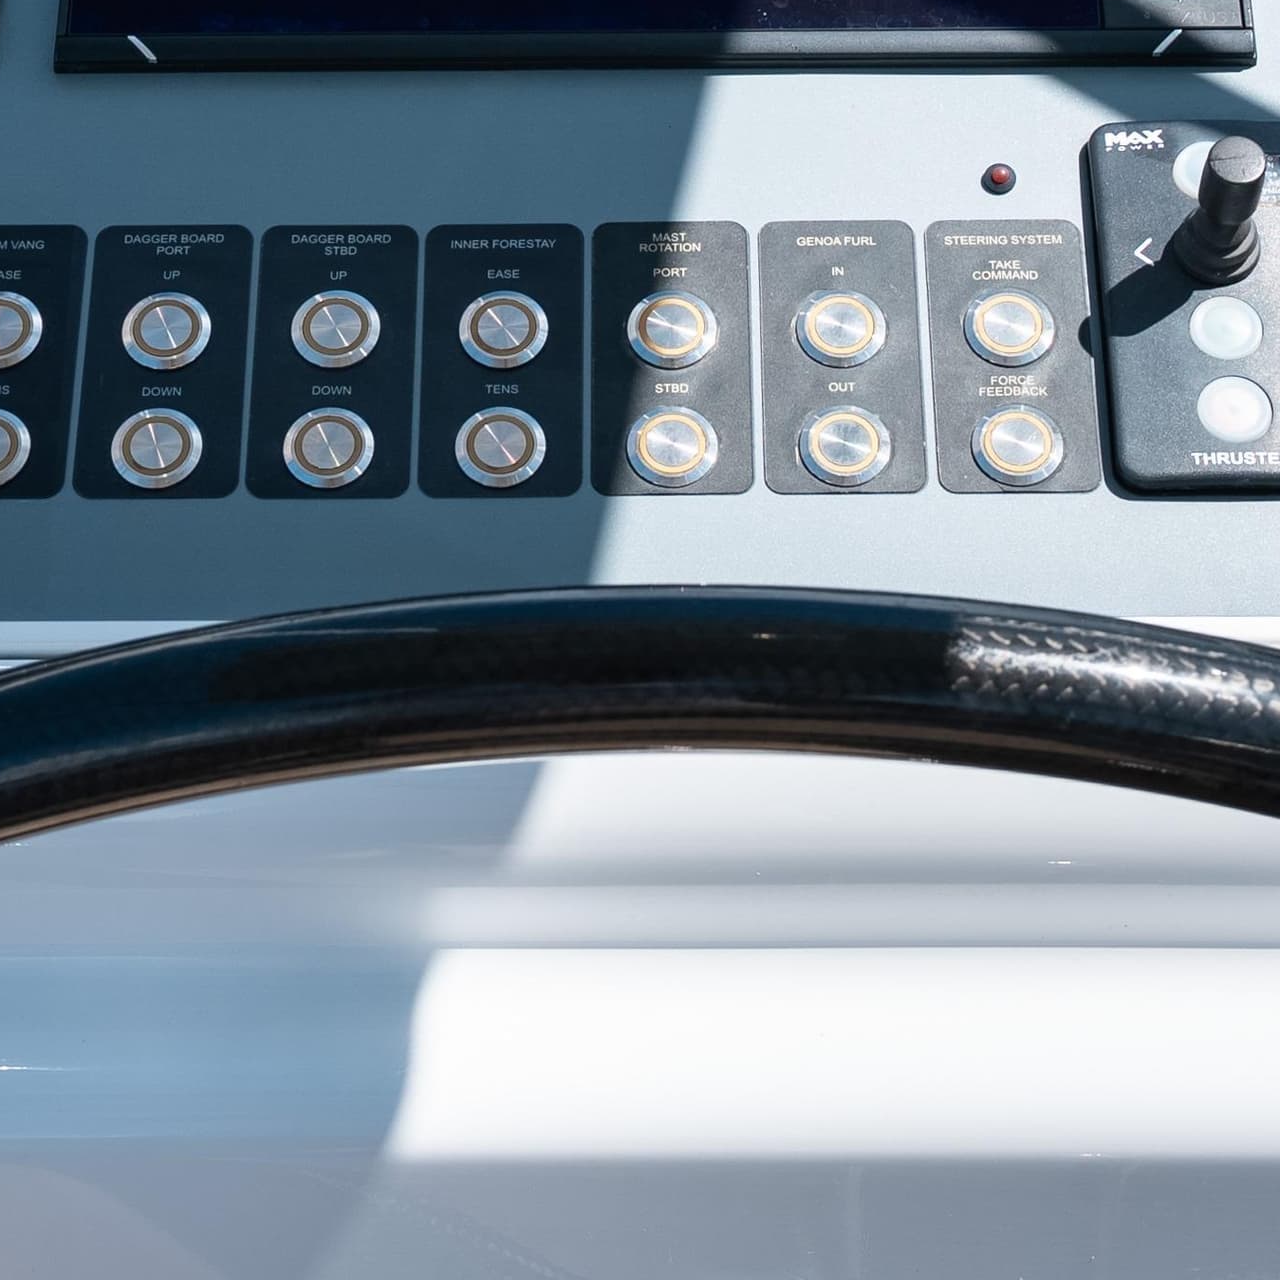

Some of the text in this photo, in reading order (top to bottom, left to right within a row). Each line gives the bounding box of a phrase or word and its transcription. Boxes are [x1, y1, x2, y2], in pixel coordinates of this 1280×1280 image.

[1104, 128, 1164, 146] MAX
[1105, 144, 1164, 152] POWER
[124, 234, 226, 244] DAGGER BOARD
[290, 234, 392, 245] DAGGER BOARD
[652, 232, 688, 244] MAST
[796, 236, 877, 247] GENOA FURL
[944, 234, 1062, 246] STEERING SYSTEM
[9, 240, 46, 250] VANG
[450, 238, 556, 250] INNER FORESTAY
[638, 242, 702, 253] ROTATION
[156, 246, 191, 256] PORT
[324, 246, 358, 256] STBD
[988, 260, 1022, 270] TAKE
[162, 270, 181, 280] UP
[329, 270, 348, 280] UP
[486, 268, 520, 280] EASE
[652, 267, 688, 278] PORT
[831, 266, 844, 276] IN
[972, 270, 1039, 282] COMMAND
[990, 376, 1035, 386] FORCE
[142, 386, 182, 397] DOWN
[311, 386, 352, 396] DOWN
[485, 384, 520, 395] TENS
[654, 383, 690, 394] STBD
[828, 382, 856, 393] OUT
[978, 386, 1048, 398] FEEDBACK
